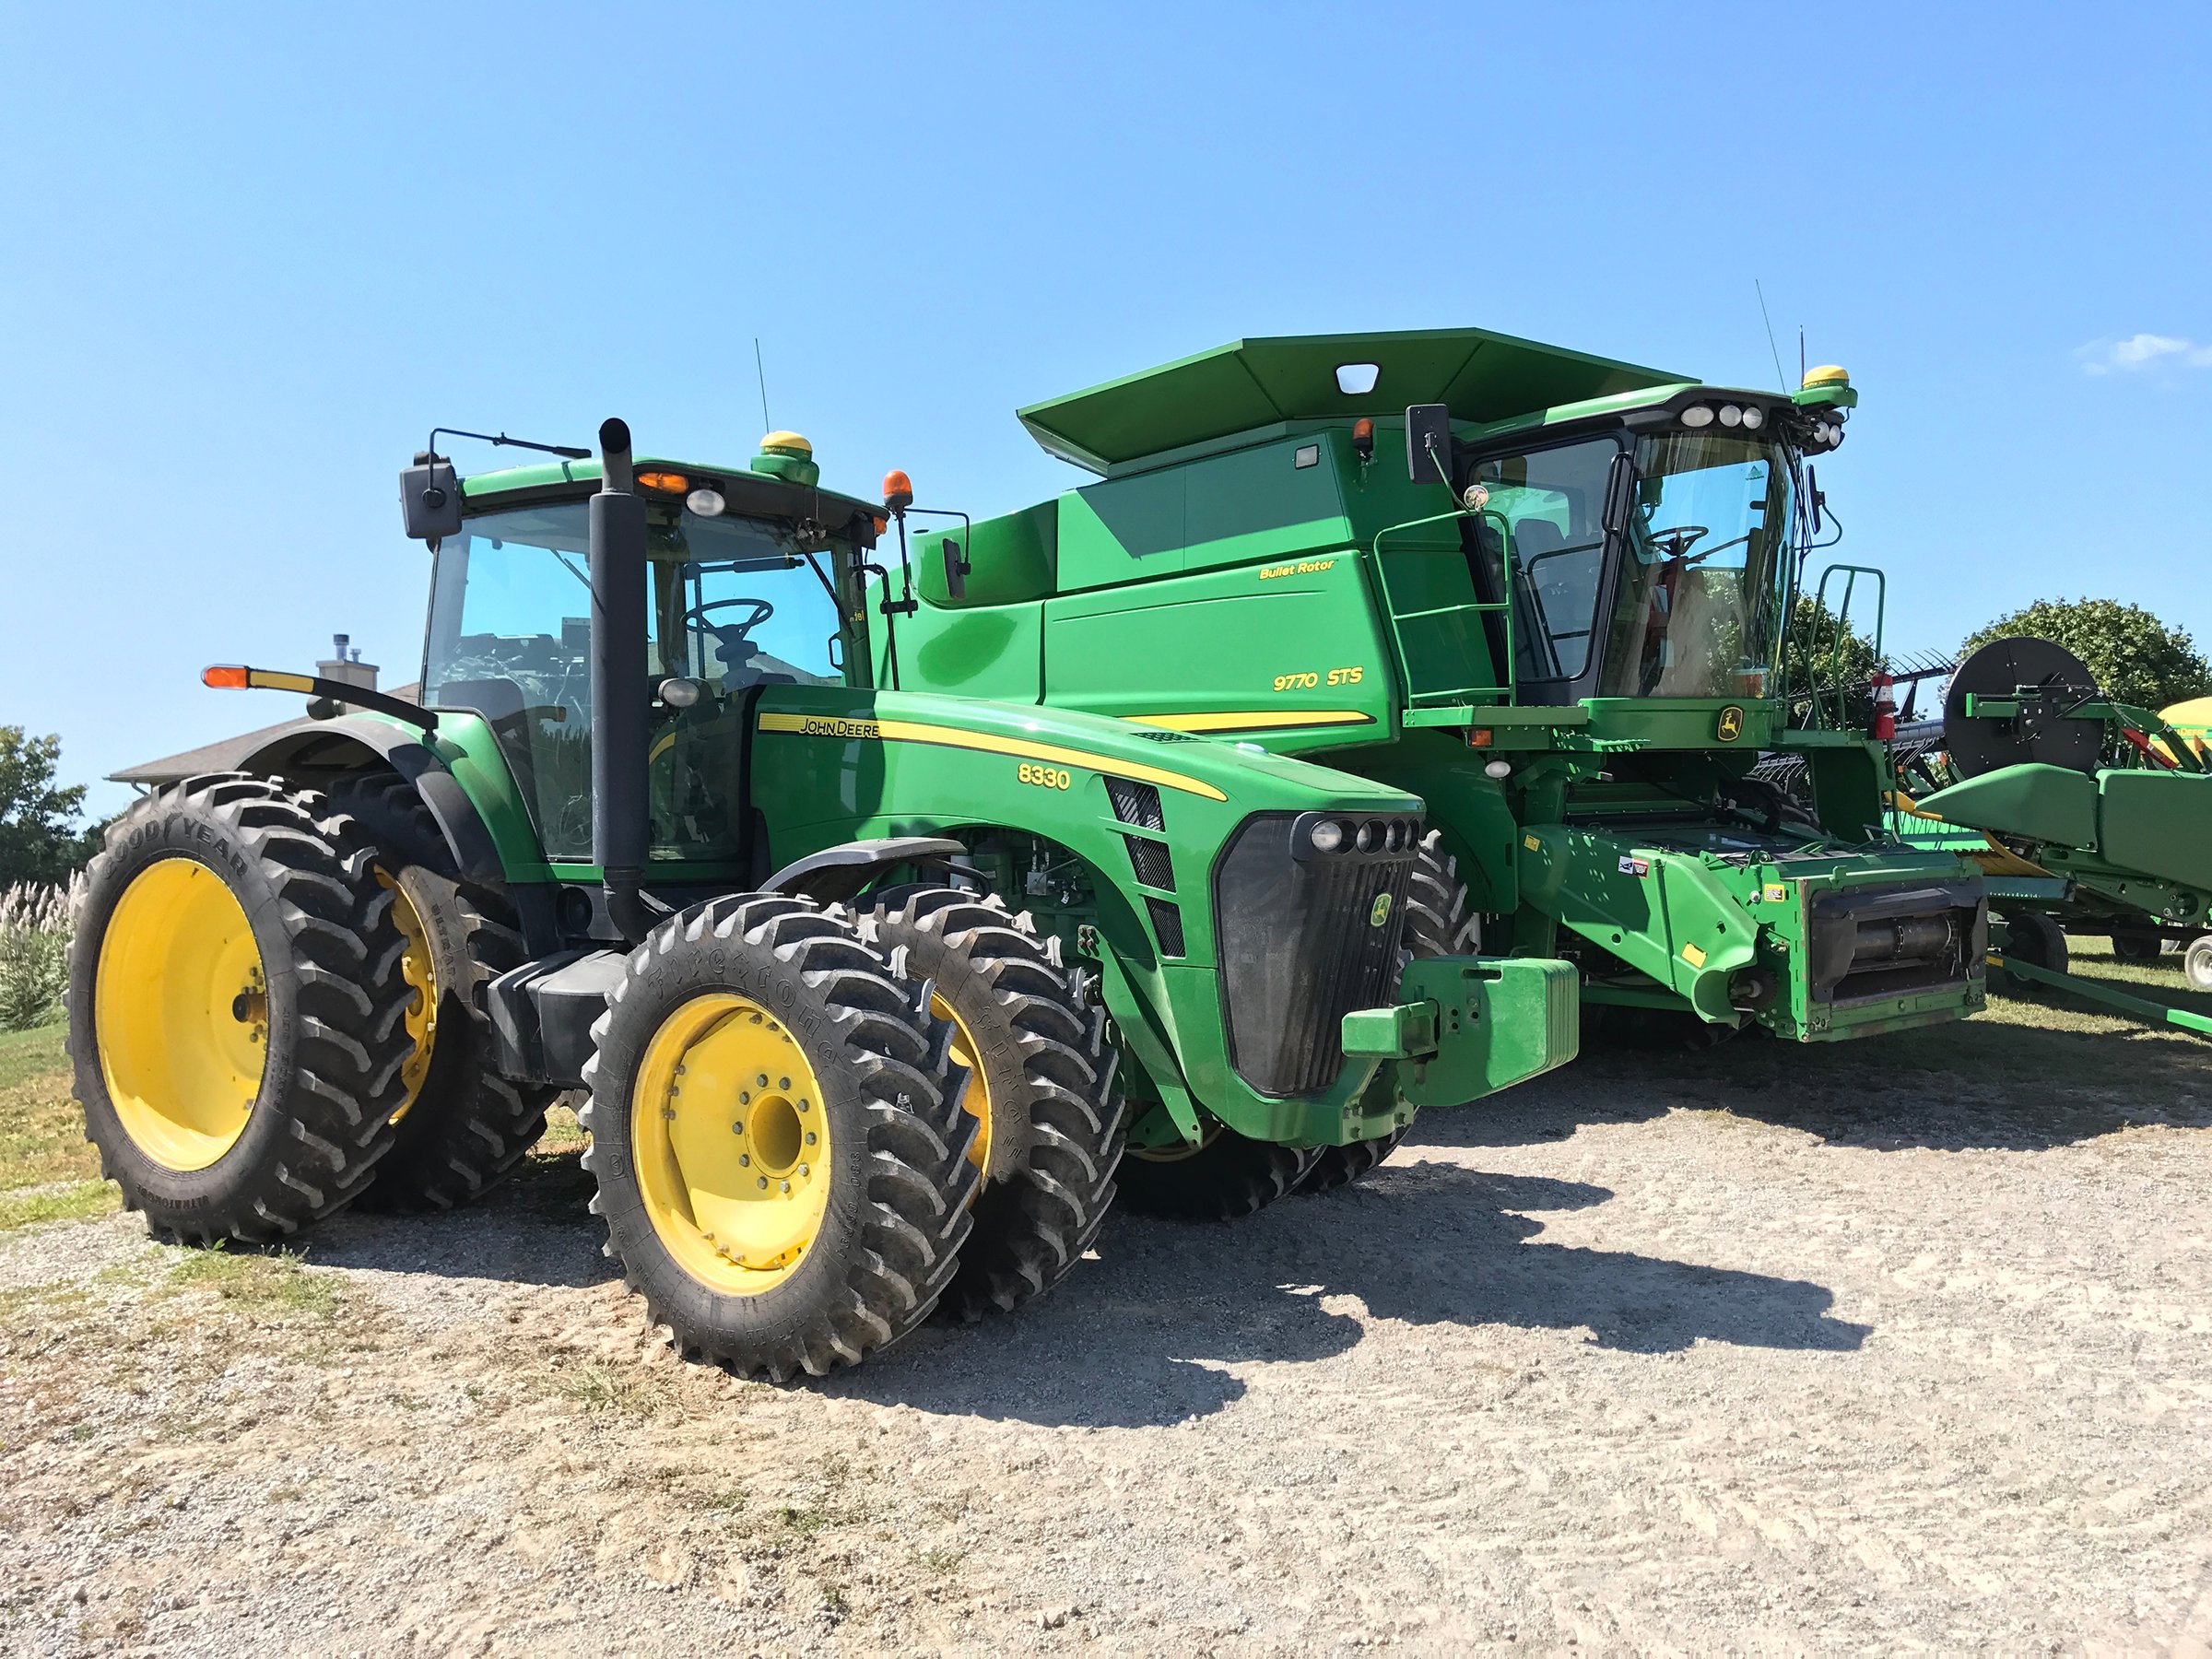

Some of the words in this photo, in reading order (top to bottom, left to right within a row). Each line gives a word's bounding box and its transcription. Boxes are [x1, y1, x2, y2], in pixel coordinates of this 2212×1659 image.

[1259, 564, 1295, 580] Bullet
[1297, 559, 1335, 574] Rotor
[1273, 671, 1318, 692] 9770
[1327, 665, 1363, 687] STS
[1018, 763, 1070, 791] 8330
